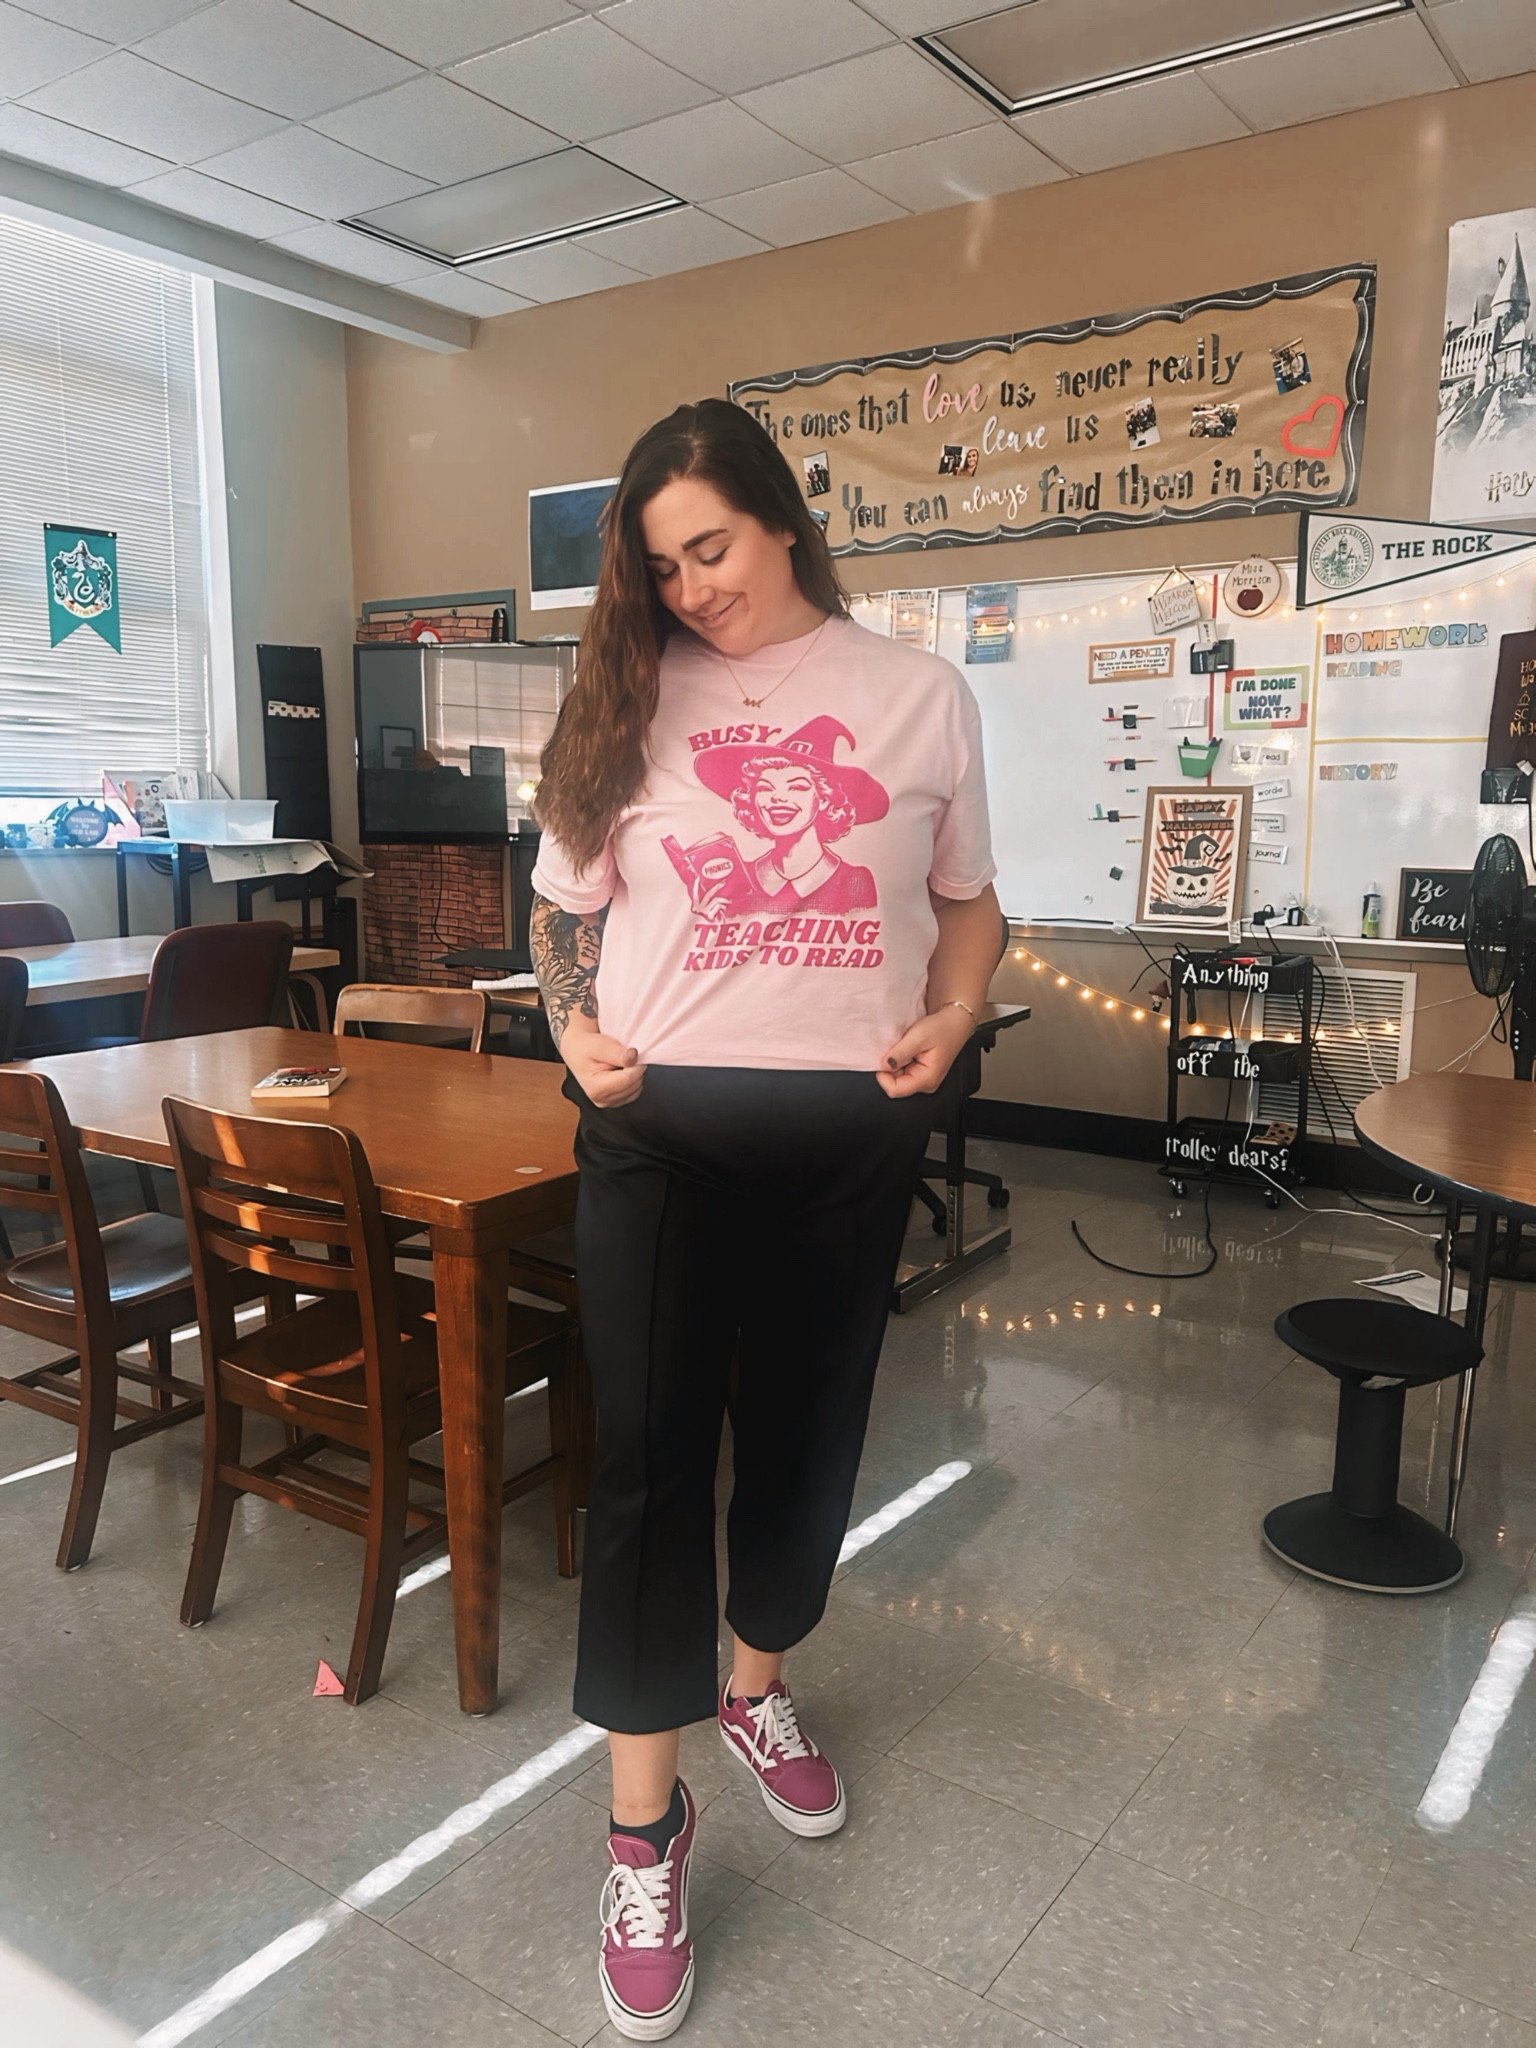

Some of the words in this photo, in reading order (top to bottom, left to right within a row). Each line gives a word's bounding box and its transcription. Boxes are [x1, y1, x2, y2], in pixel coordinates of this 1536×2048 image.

[744, 399, 794, 444] The
[801, 409, 851, 439] ones
[857, 388, 910, 434] that
[922, 372, 989, 423] love
[1055, 356, 1133, 398] never
[1147, 333, 1244, 387] really
[982, 415, 1049, 456] leave
[1066, 413, 1100, 443] us
[842, 483, 888, 536] You
[904, 494, 949, 526] can
[962, 483, 1030, 521] always
[1039, 464, 1102, 514] find
[1116, 463, 1194, 508] them
[1211, 459, 1242, 494] in
[1485, 470, 1536, 503] Harry
[1382, 541, 1425, 560] THE
[1432, 534, 1494, 556] ROCK
[1232, 576, 1271, 587] Morrison
[1242, 564, 1263, 574] Miss
[1325, 623, 1488, 655] HOMEWORK
[1094, 652, 1117, 661] NEED
[1120, 650, 1127, 660] A
[1130, 647, 1170, 659] PENCIL?
[1326, 660, 1401, 678] READING
[1236, 680, 1256, 692] I'M
[1260, 678, 1296, 691] DONE
[1239, 706, 1291, 720] WHAT?
[1248, 694, 1282, 707] NOW
[687, 723, 782, 752] BUSY
[1319, 763, 1398, 780] HISTORY
[1175, 803, 1222, 813] HAPPY
[1165, 821, 1233, 831] HALLOWEEN
[1254, 849, 1281, 859] journal
[1411, 877, 1450, 903] Be
[694, 917, 881, 948] TEACHING
[683, 949, 754, 972] KIDS
[758, 946, 799, 966] TO
[802, 947, 884, 969] READ
[1182, 963, 1269, 993] Anything
[1177, 1051, 1213, 1077] off
[1234, 1054, 1260, 1078] the
[1229, 1144, 1289, 1171] dears?
